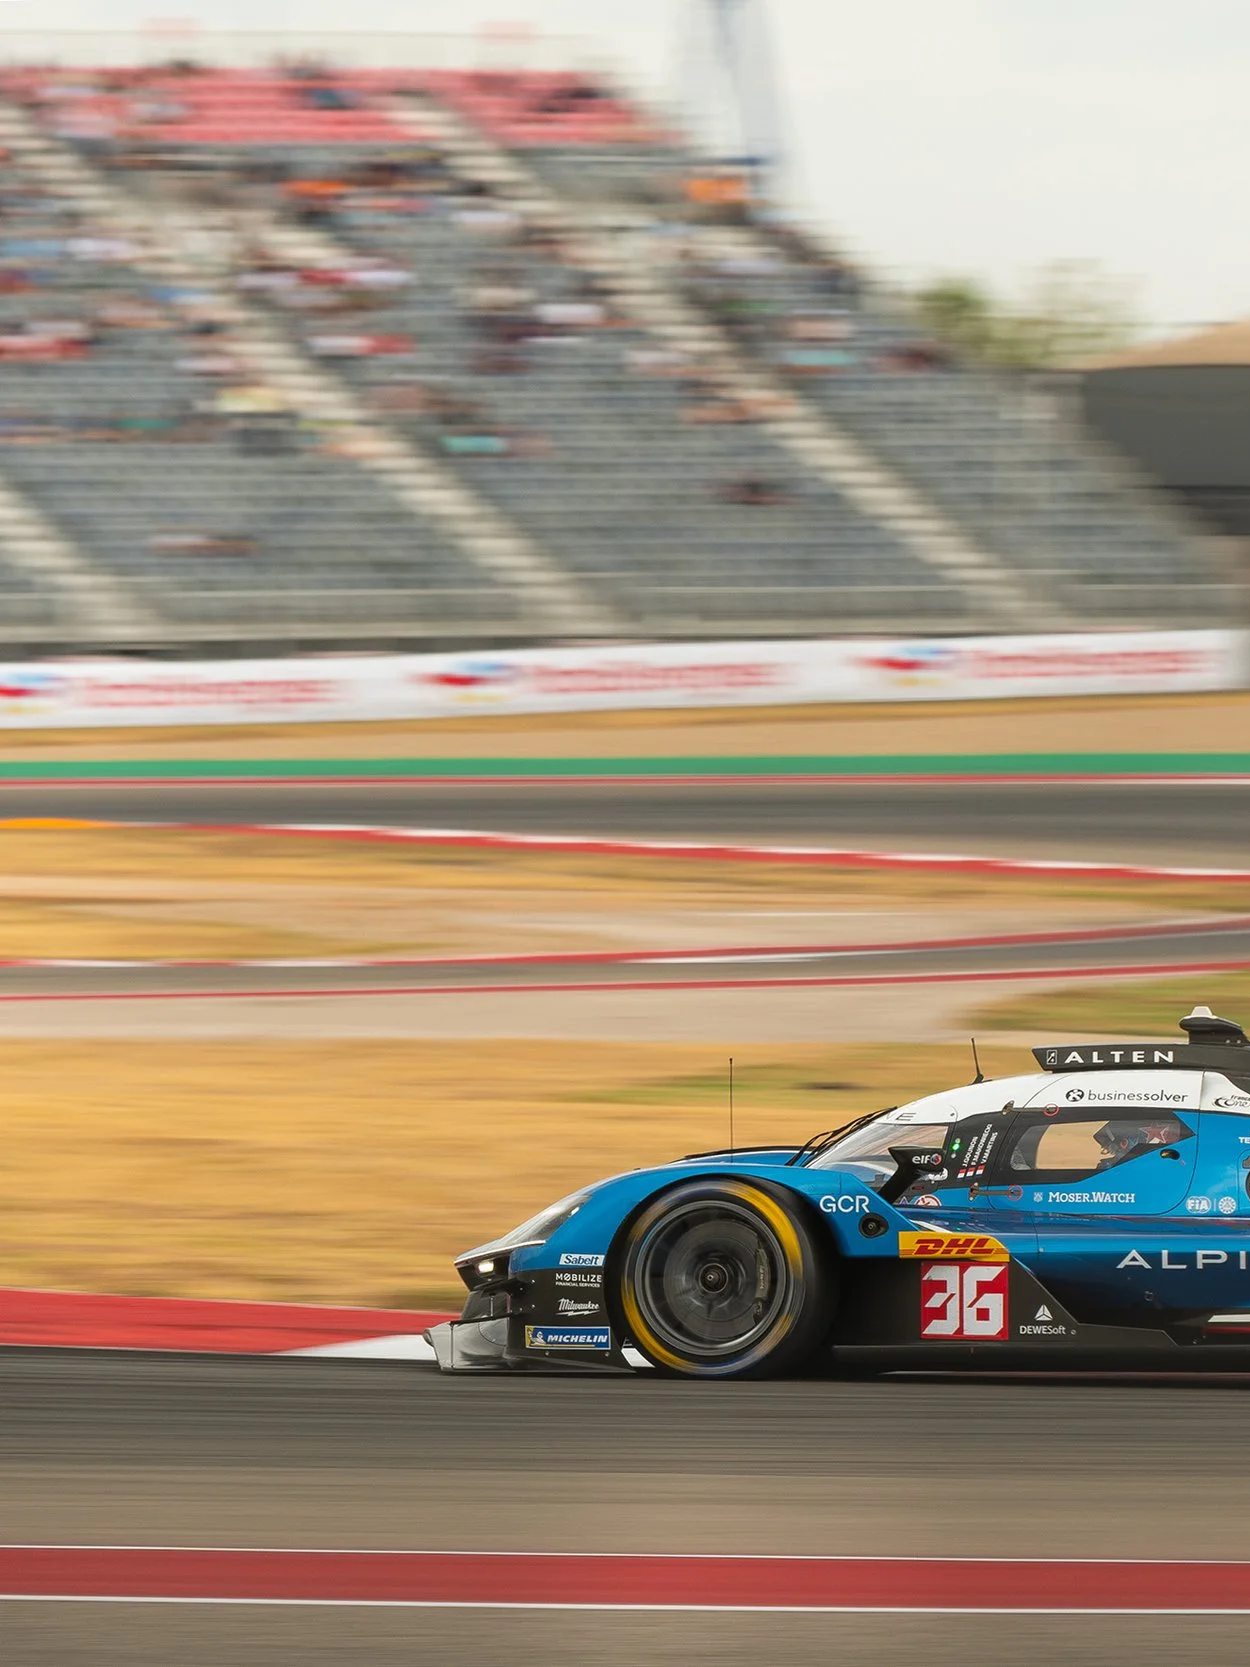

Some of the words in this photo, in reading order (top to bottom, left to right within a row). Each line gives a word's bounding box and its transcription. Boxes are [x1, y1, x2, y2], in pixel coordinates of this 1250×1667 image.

[1064, 1051, 1175, 1064] ALTEN
[1087, 1089, 1189, 1103] businessolver
[912, 1154, 931, 1165] elf
[1048, 1191, 1136, 1204] MOSER.WATCH
[819, 1195, 871, 1214] GCR
[914, 1238, 995, 1255] DHL
[564, 1254, 600, 1266] Sabelt
[558, 1297, 600, 1311] Milwaukee
[922, 1265, 1006, 1336] 36
[1019, 1324, 1067, 1336] DEWESoft
[547, 1334, 609, 1343] MICHELIN
